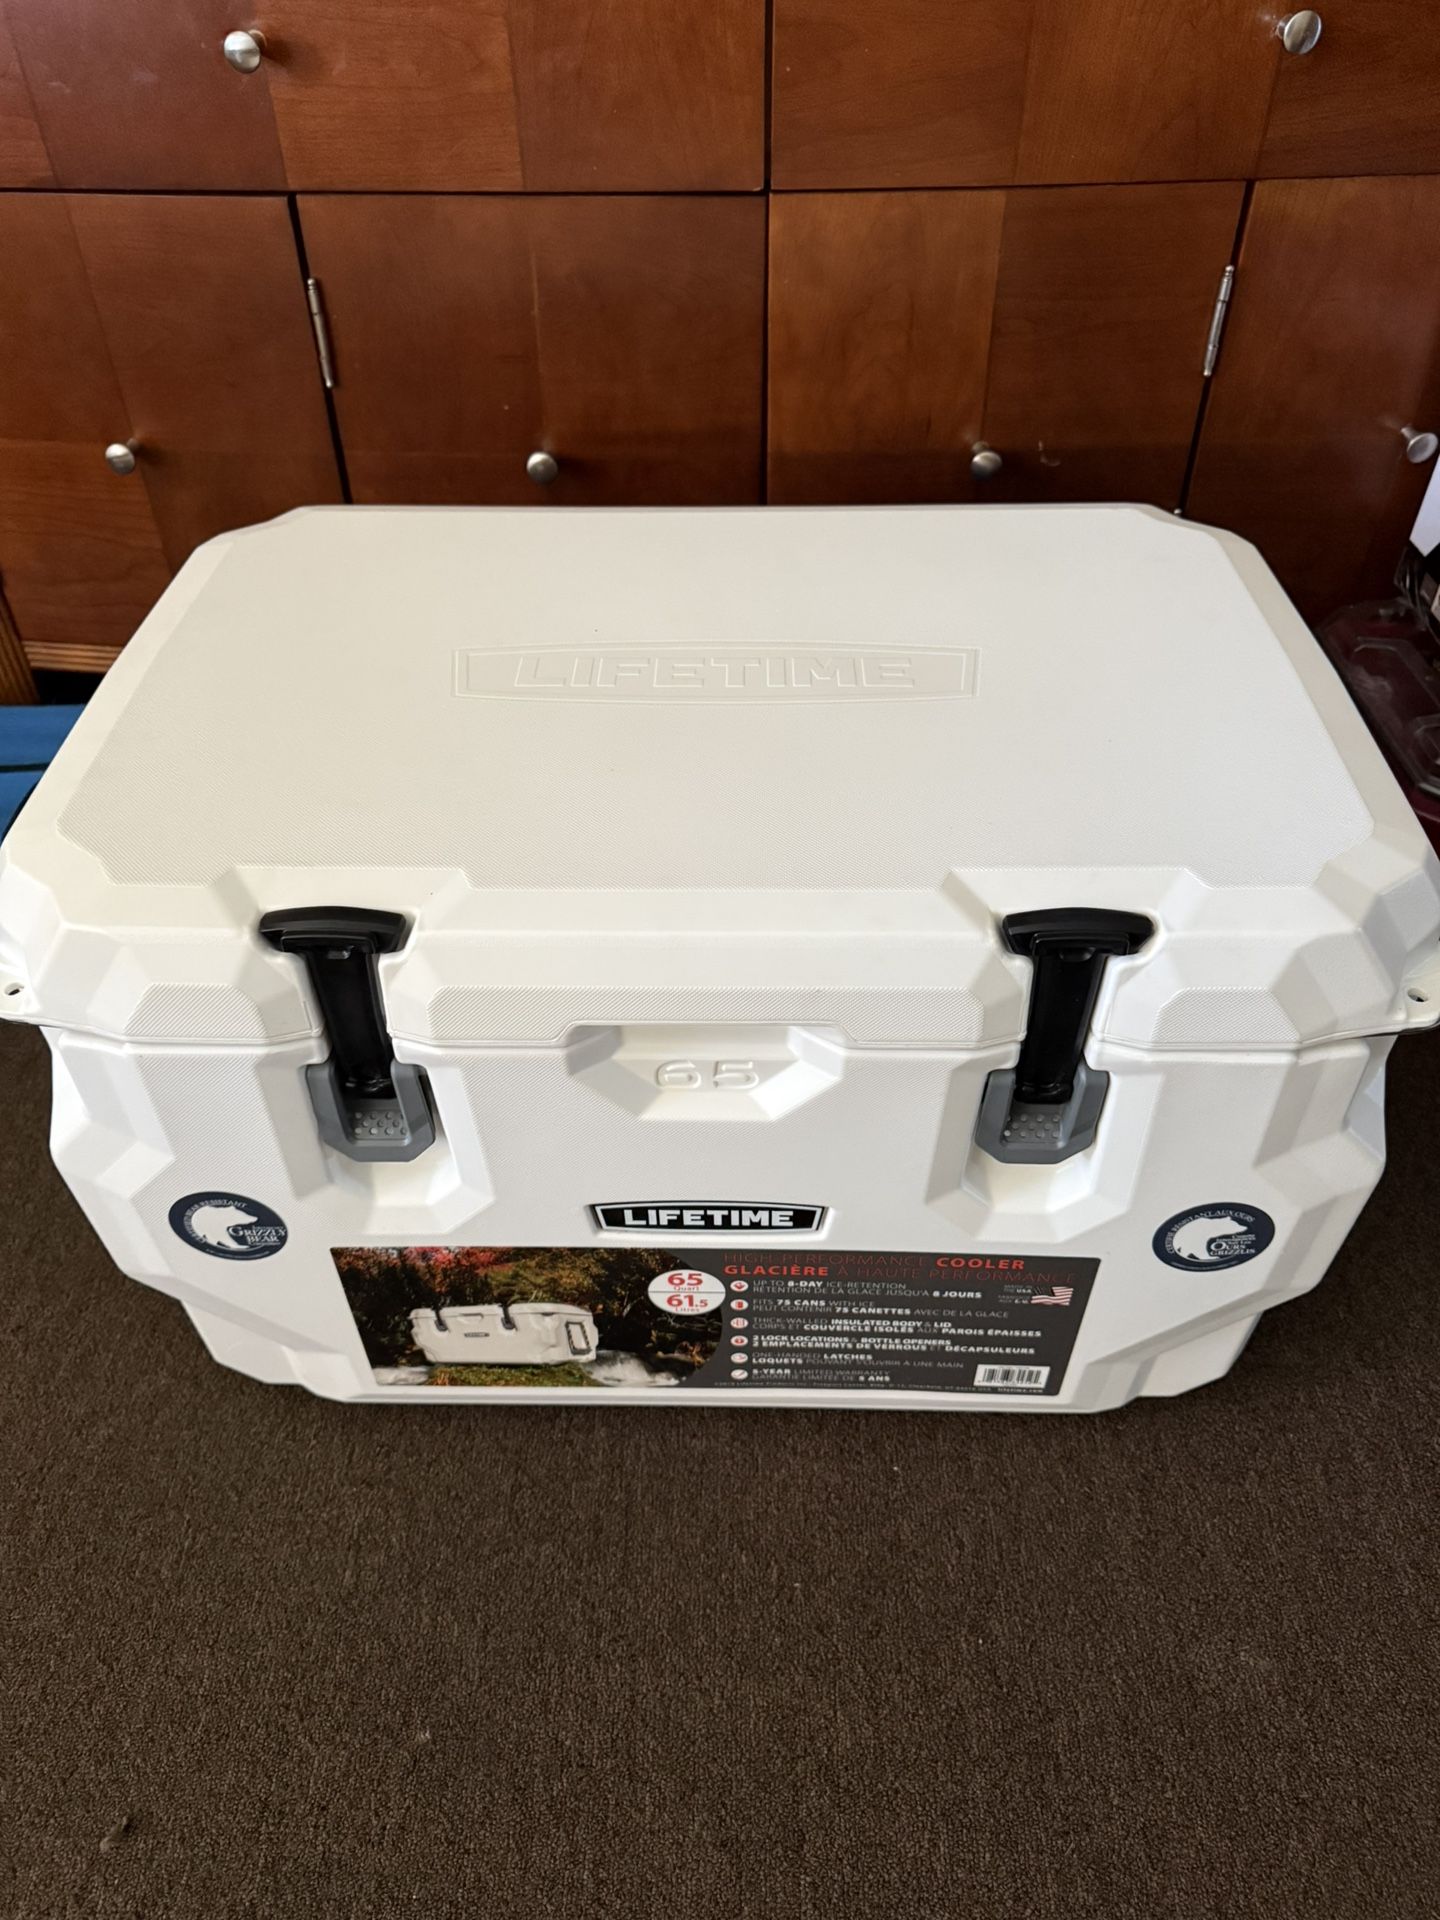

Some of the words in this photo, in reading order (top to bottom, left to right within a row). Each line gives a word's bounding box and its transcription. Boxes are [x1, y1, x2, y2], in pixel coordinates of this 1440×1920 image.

[514, 657, 915, 688] LIFETIME
[624, 1209, 794, 1227] LIFETIME
[229, 1226, 287, 1238] GRIZZLY
[1211, 1241, 1246, 1251] OURS
[936, 1258, 1025, 1270] COOLER
[668, 1273, 703, 1286] 65
[724, 1264, 829, 1276] GLACIÈRE
[857, 1268, 920, 1279] HAUTE
[929, 1270, 1077, 1284] PERFORMANCE
[826, 1281, 906, 1289] ICE-RETENTION
[847, 1287, 881, 1295] GLACE
[667, 1295, 708, 1307] 61.5
[852, 1307, 910, 1315] CANETTES
[975, 1310, 1009, 1318] GLACE
[987, 1328, 1042, 1337] ÉPAISSES
[762, 1341, 853, 1349] EMPLACEMENTS
[945, 1345, 1035, 1354] DÉCAPSULEURS
